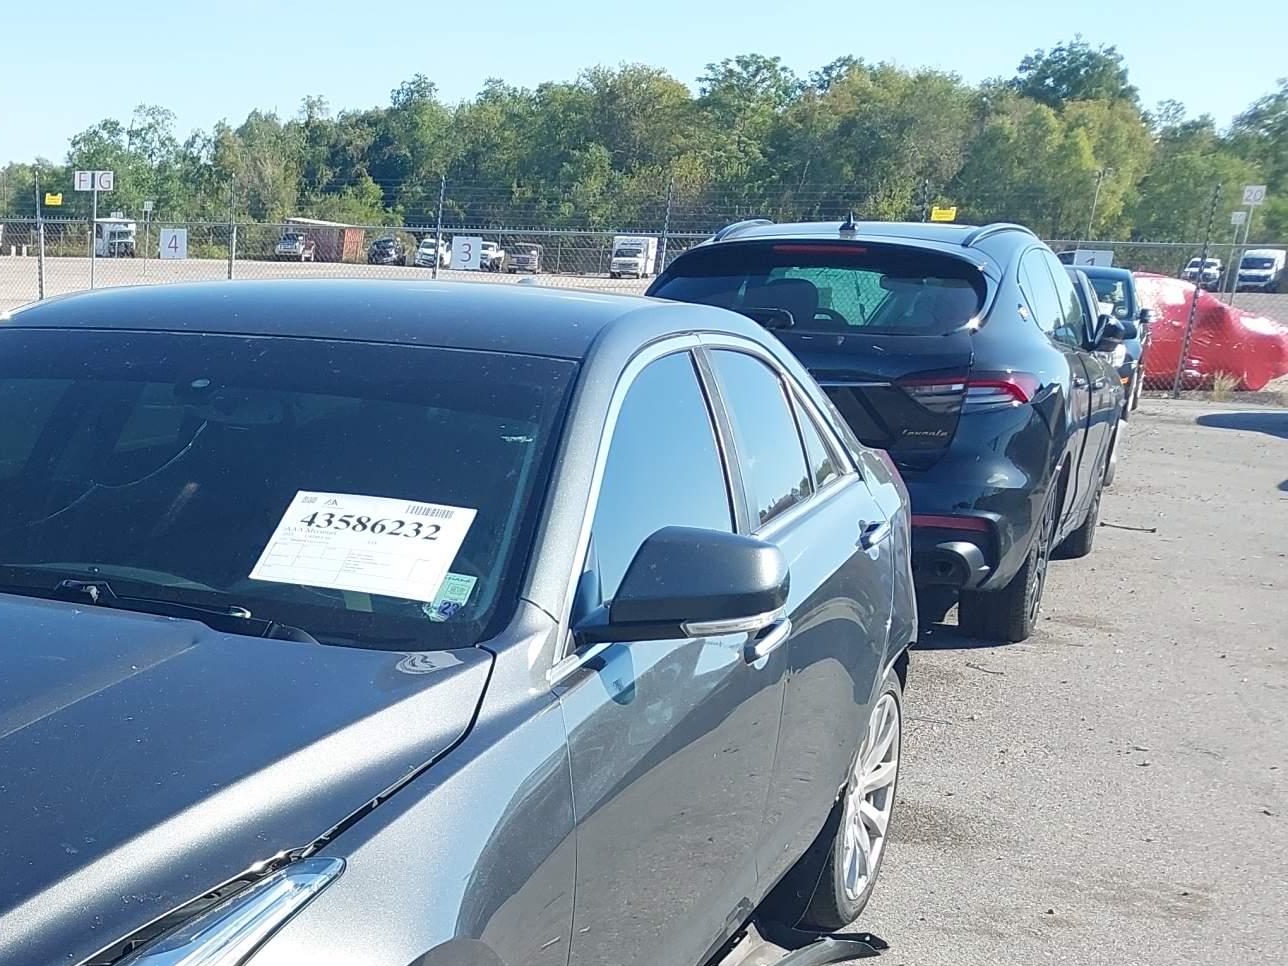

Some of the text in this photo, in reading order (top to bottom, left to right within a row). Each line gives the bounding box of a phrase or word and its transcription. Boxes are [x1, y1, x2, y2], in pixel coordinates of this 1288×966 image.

[78, 172, 112, 190] F G
[1245, 189, 1264, 202] 20
[167, 234, 179, 253] 4
[460, 243, 472, 262] 3
[300, 511, 442, 541] 43586232
